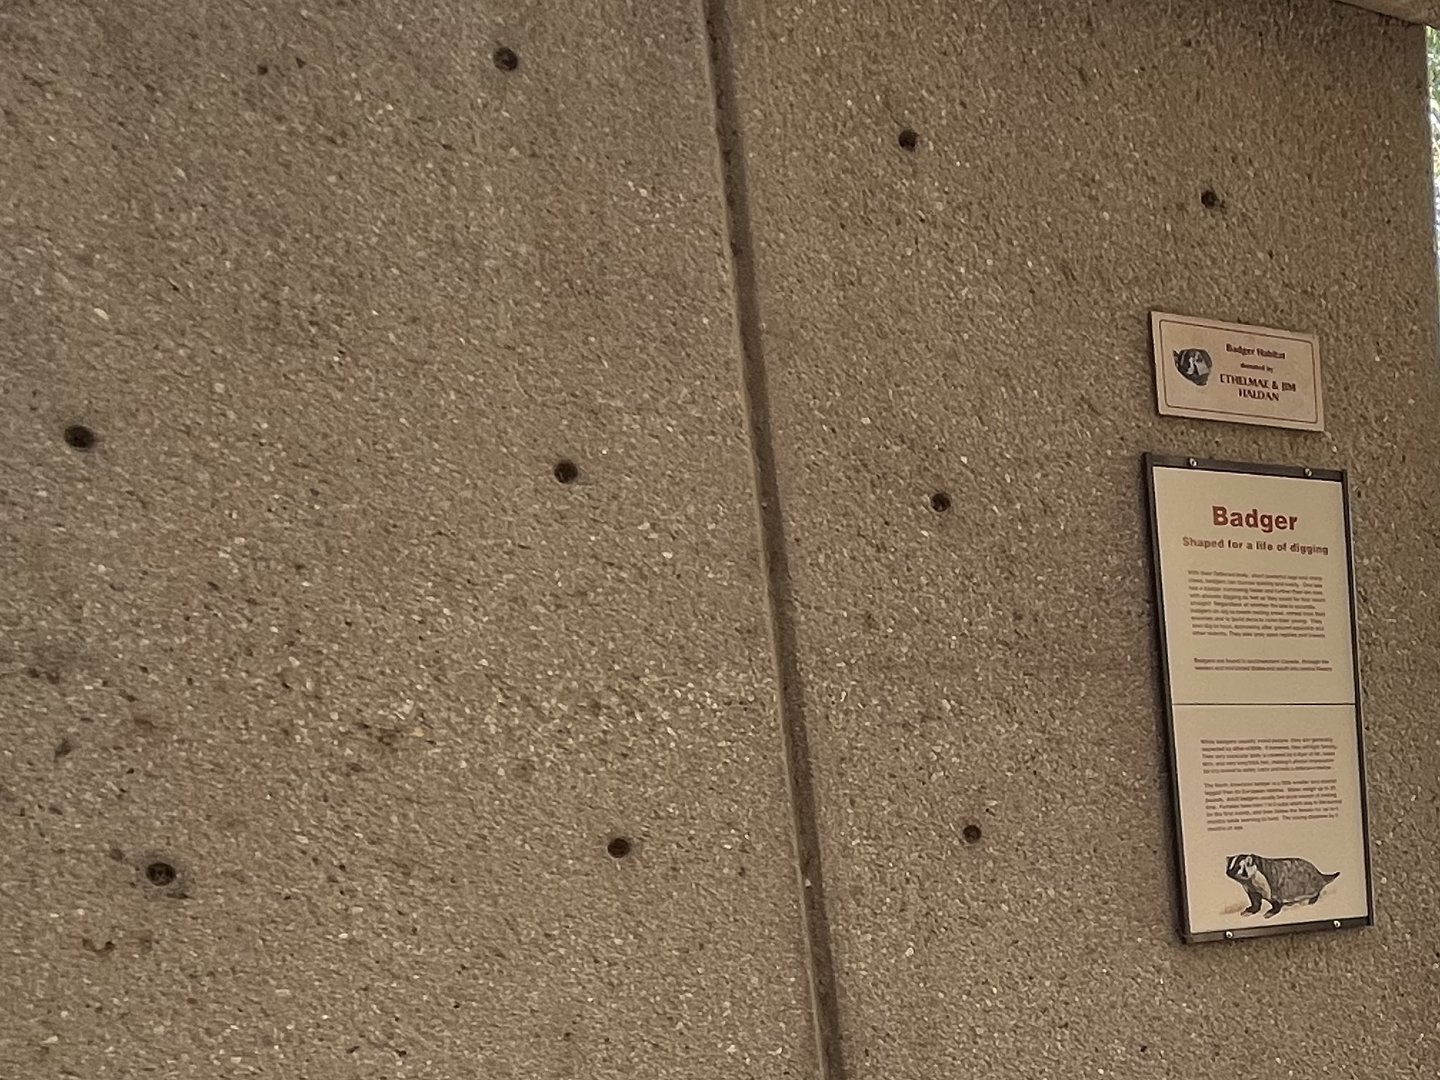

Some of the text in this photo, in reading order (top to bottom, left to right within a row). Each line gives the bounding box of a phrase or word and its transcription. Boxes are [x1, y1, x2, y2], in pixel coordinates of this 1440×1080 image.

[1226, 344, 1255, 355] Badger
[1271, 380, 1279, 390] &
[1281, 381, 1296, 392] JIM
[1238, 388, 1279, 401] HALDAN
[1212, 506, 1298, 533] Badger
[1182, 536, 1329, 555] Shaped for a life of digging
